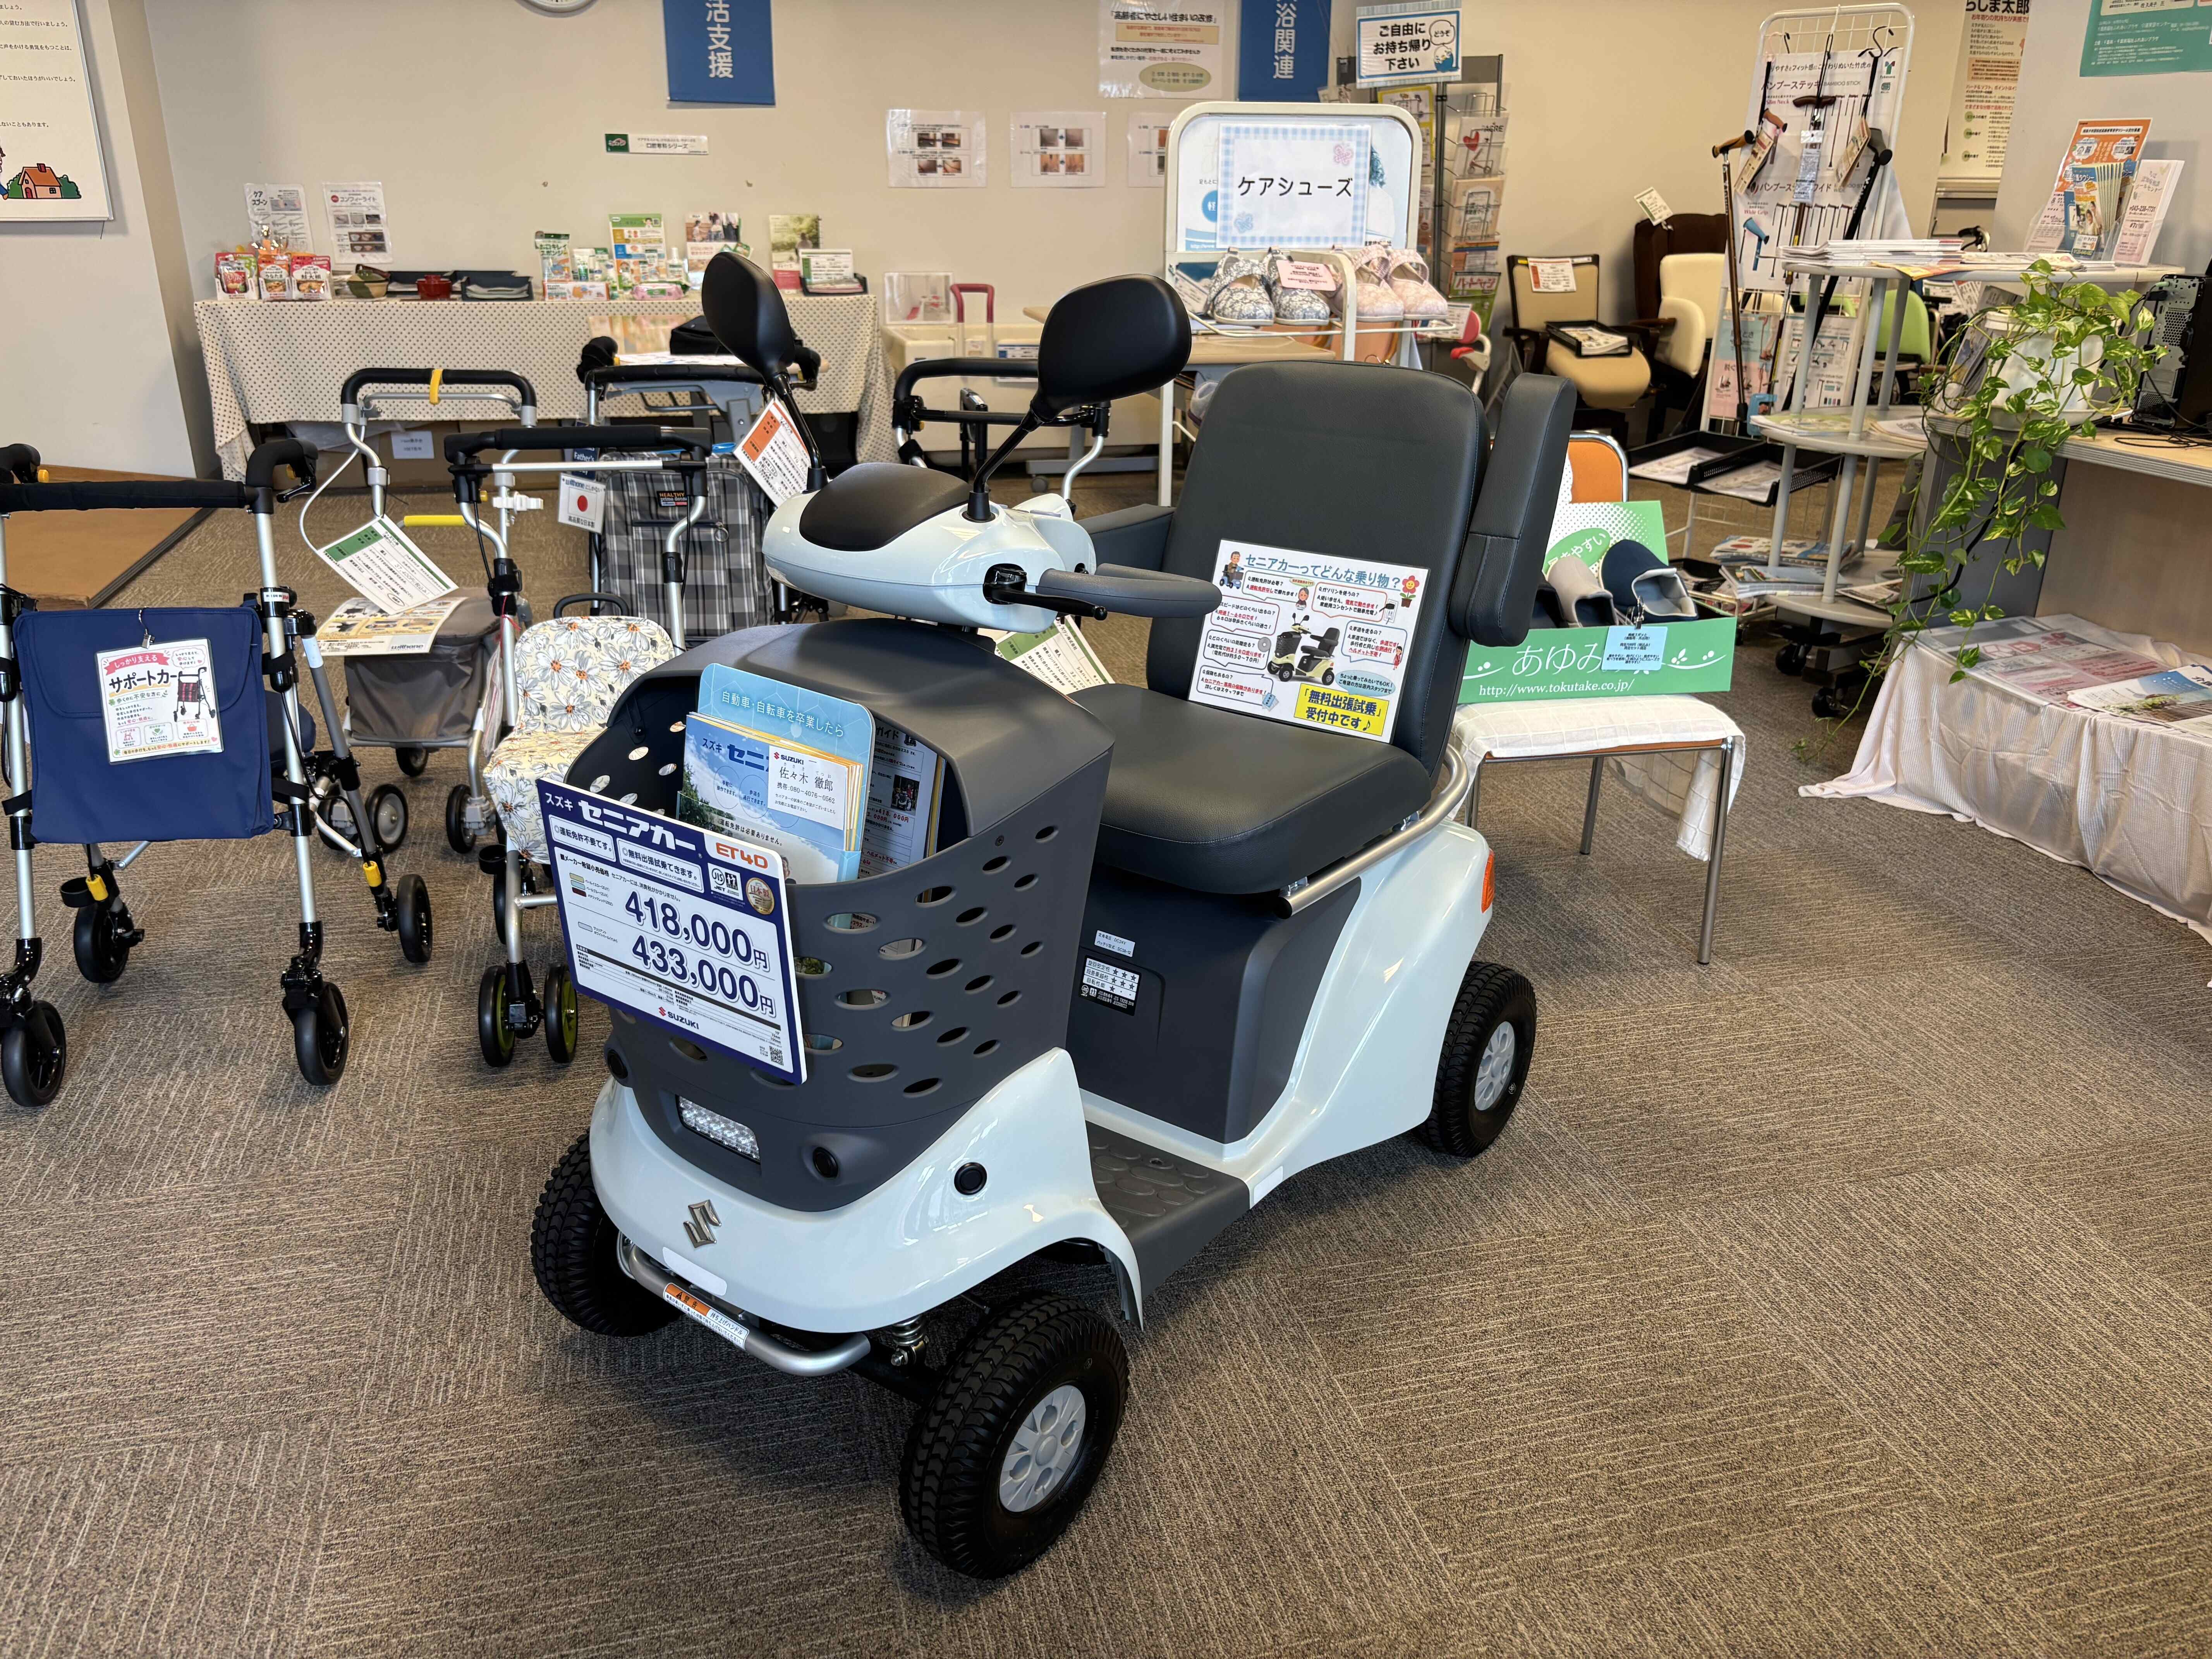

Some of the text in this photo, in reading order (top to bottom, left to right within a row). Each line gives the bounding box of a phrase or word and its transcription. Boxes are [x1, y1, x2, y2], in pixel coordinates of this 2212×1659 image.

[1379, 22, 1426, 37] ご自由に
[1273, 0, 1297, 79] 浴関連
[1373, 39, 1431, 55] お持ち帰り
[1385, 57, 1420, 71] 下さい
[1238, 177, 1353, 197] ケアシューズ
[1759, 183, 1831, 192] バンブースワイド
[574, 452, 595, 462] Father's
[1548, 533, 1606, 566] やすい
[1245, 553, 1401, 589] セニアカーってどんな乗り物？
[1220, 602, 1276, 615] スピードはどのくらい出るの？
[114, 654, 158, 668] しっかり支える
[109, 669, 177, 693] サポートカー
[1205, 684, 1244, 696] 詳しくはスタッフまで
[1338, 679, 1392, 694] ご希望の方は店内スタッフまで
[1479, 678, 1635, 697] http://www.tokutake.co.jp/
[1304, 688, 1382, 717] 「無料出張試乗」
[722, 690, 844, 738] 自動車・自転車を卒業したら
[702, 738, 722, 754] スズキ
[727, 743, 769, 772] セニ
[781, 754, 804, 765] SUZUKI
[779, 766, 808, 784] 佐々木
[544, 792, 574, 812] スズキ
[577, 799, 696, 851] セニアカー
[720, 819, 783, 846] 運転免許は必要ありません。
[716, 842, 768, 869] ET4D
[750, 884, 770, 898] 日本製
[668, 1011, 699, 1030] SUZUKI
